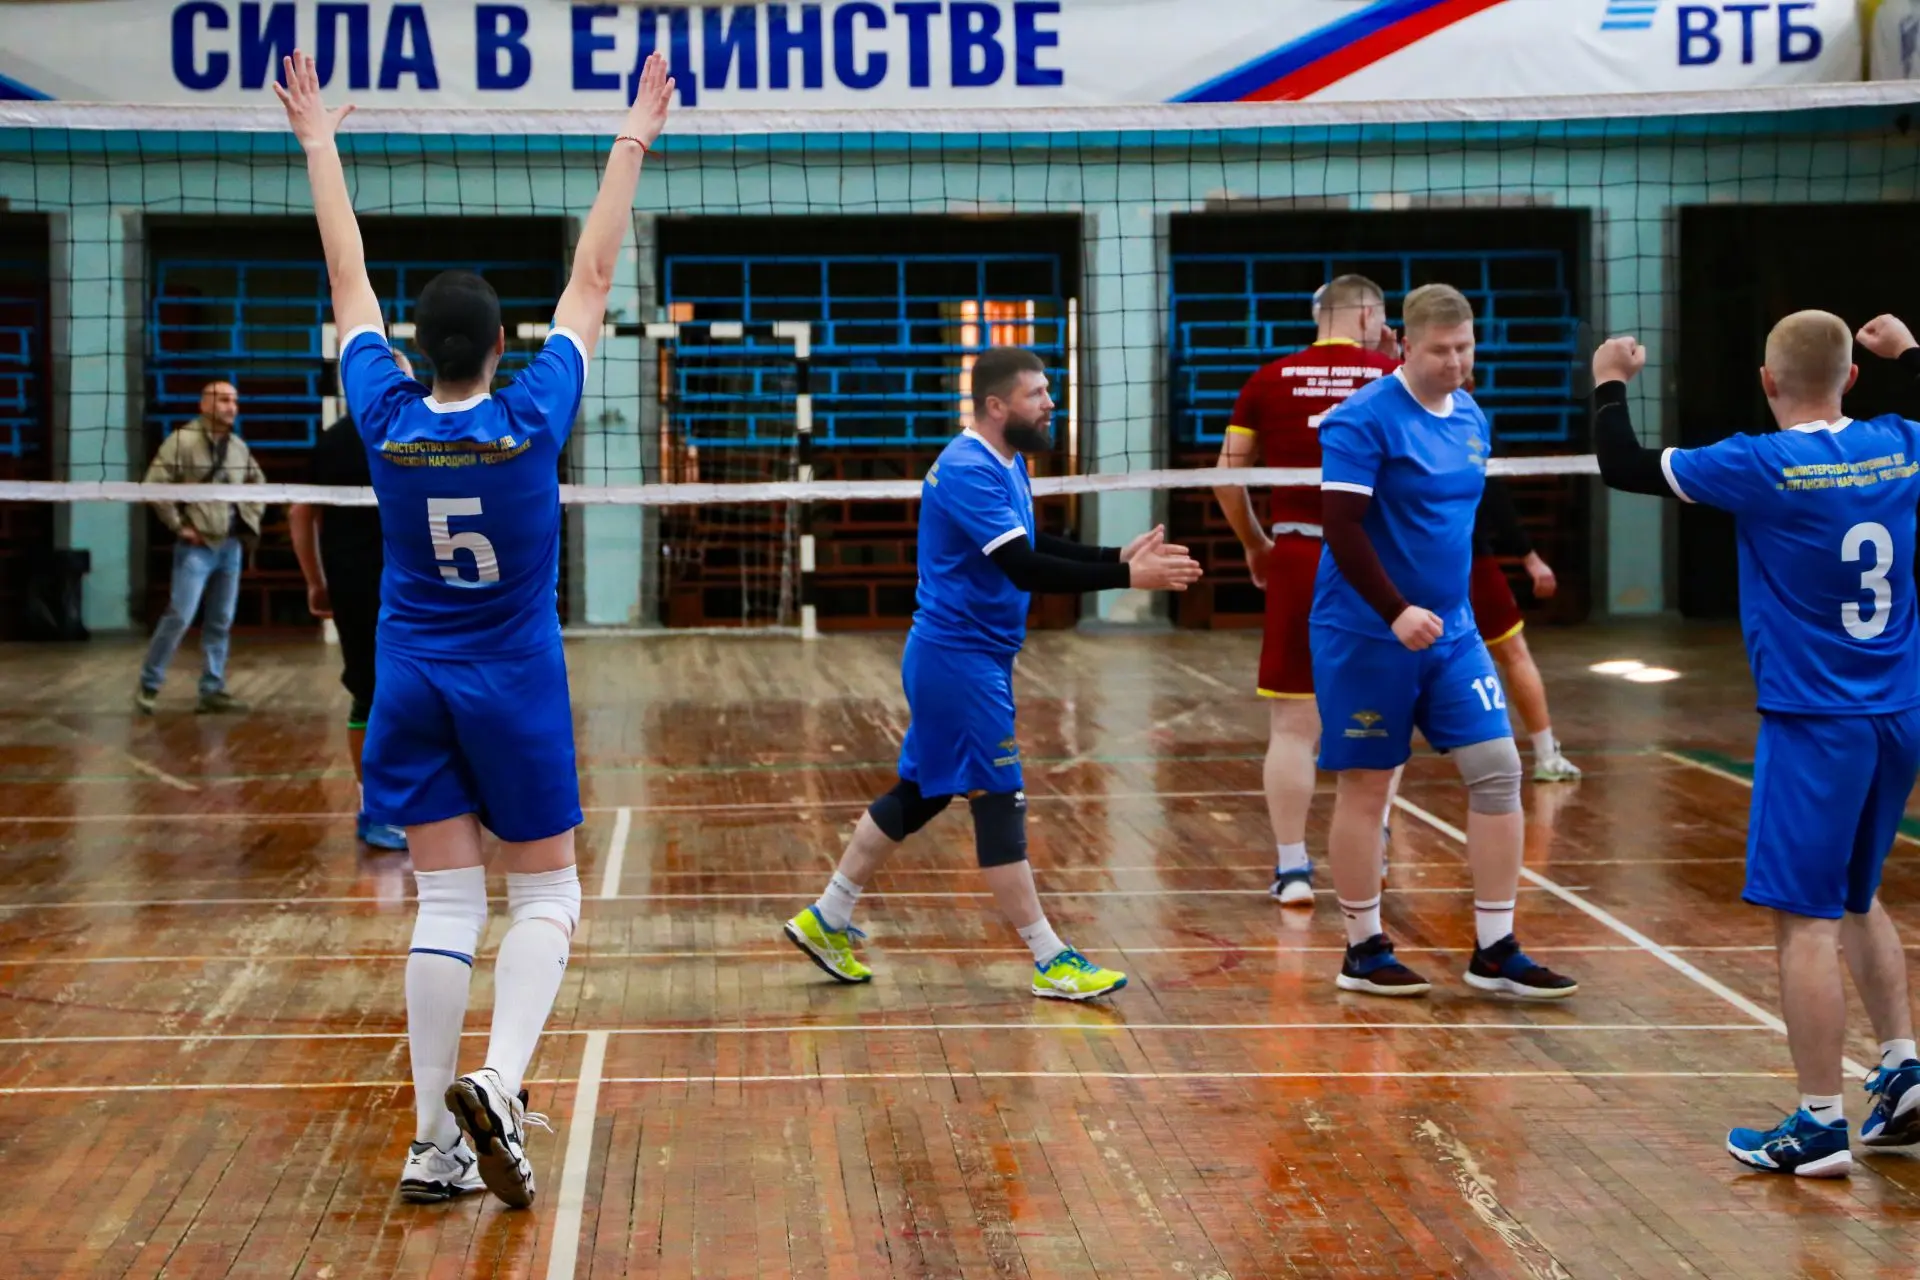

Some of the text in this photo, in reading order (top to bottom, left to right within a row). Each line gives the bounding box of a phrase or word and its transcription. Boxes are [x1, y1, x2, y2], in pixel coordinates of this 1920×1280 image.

[171, 1, 1064, 107] СИЛА В ЕДИНСТВЕ
[1677, 2, 1824, 67] ВТБ
[428, 454, 477, 468] НАРОДНОЙ
[426, 496, 500, 589] 5
[1841, 521, 1894, 640] 3
[1471, 676, 1506, 711] 12
